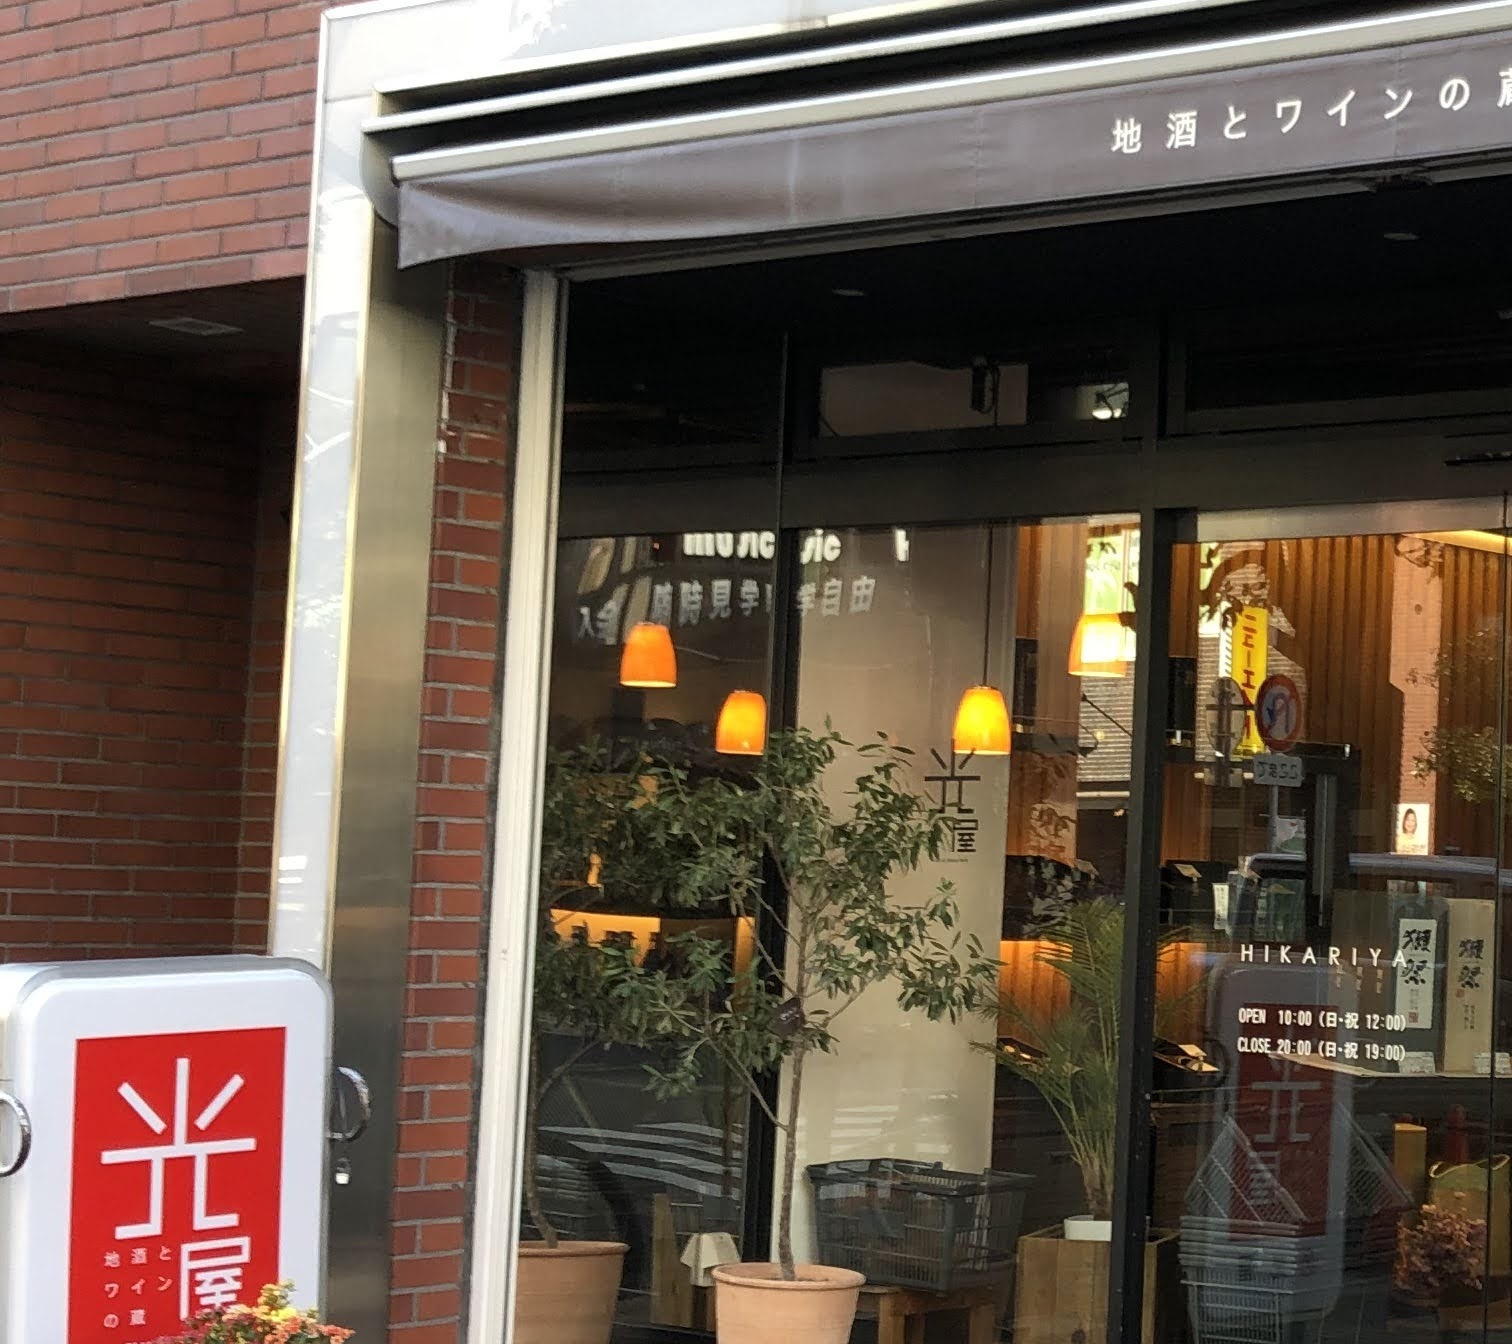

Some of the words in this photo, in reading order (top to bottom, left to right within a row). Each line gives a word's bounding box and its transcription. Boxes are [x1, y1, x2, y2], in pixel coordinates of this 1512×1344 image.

[924, 737, 982, 853] 光屋
[1239, 943, 1409, 969] HIKARIYA
[1238, 1007, 1267, 1025] OPEN
[1277, 1009, 1313, 1027] 10:00
[1236, 1036, 1272, 1054] CLOSE
[1277, 1038, 1312, 1056] 20:00
[100, 1057, 258, 1321] 光屋
[103, 1245, 173, 1269] 地酒と
[104, 1275, 174, 1299] ワイン
